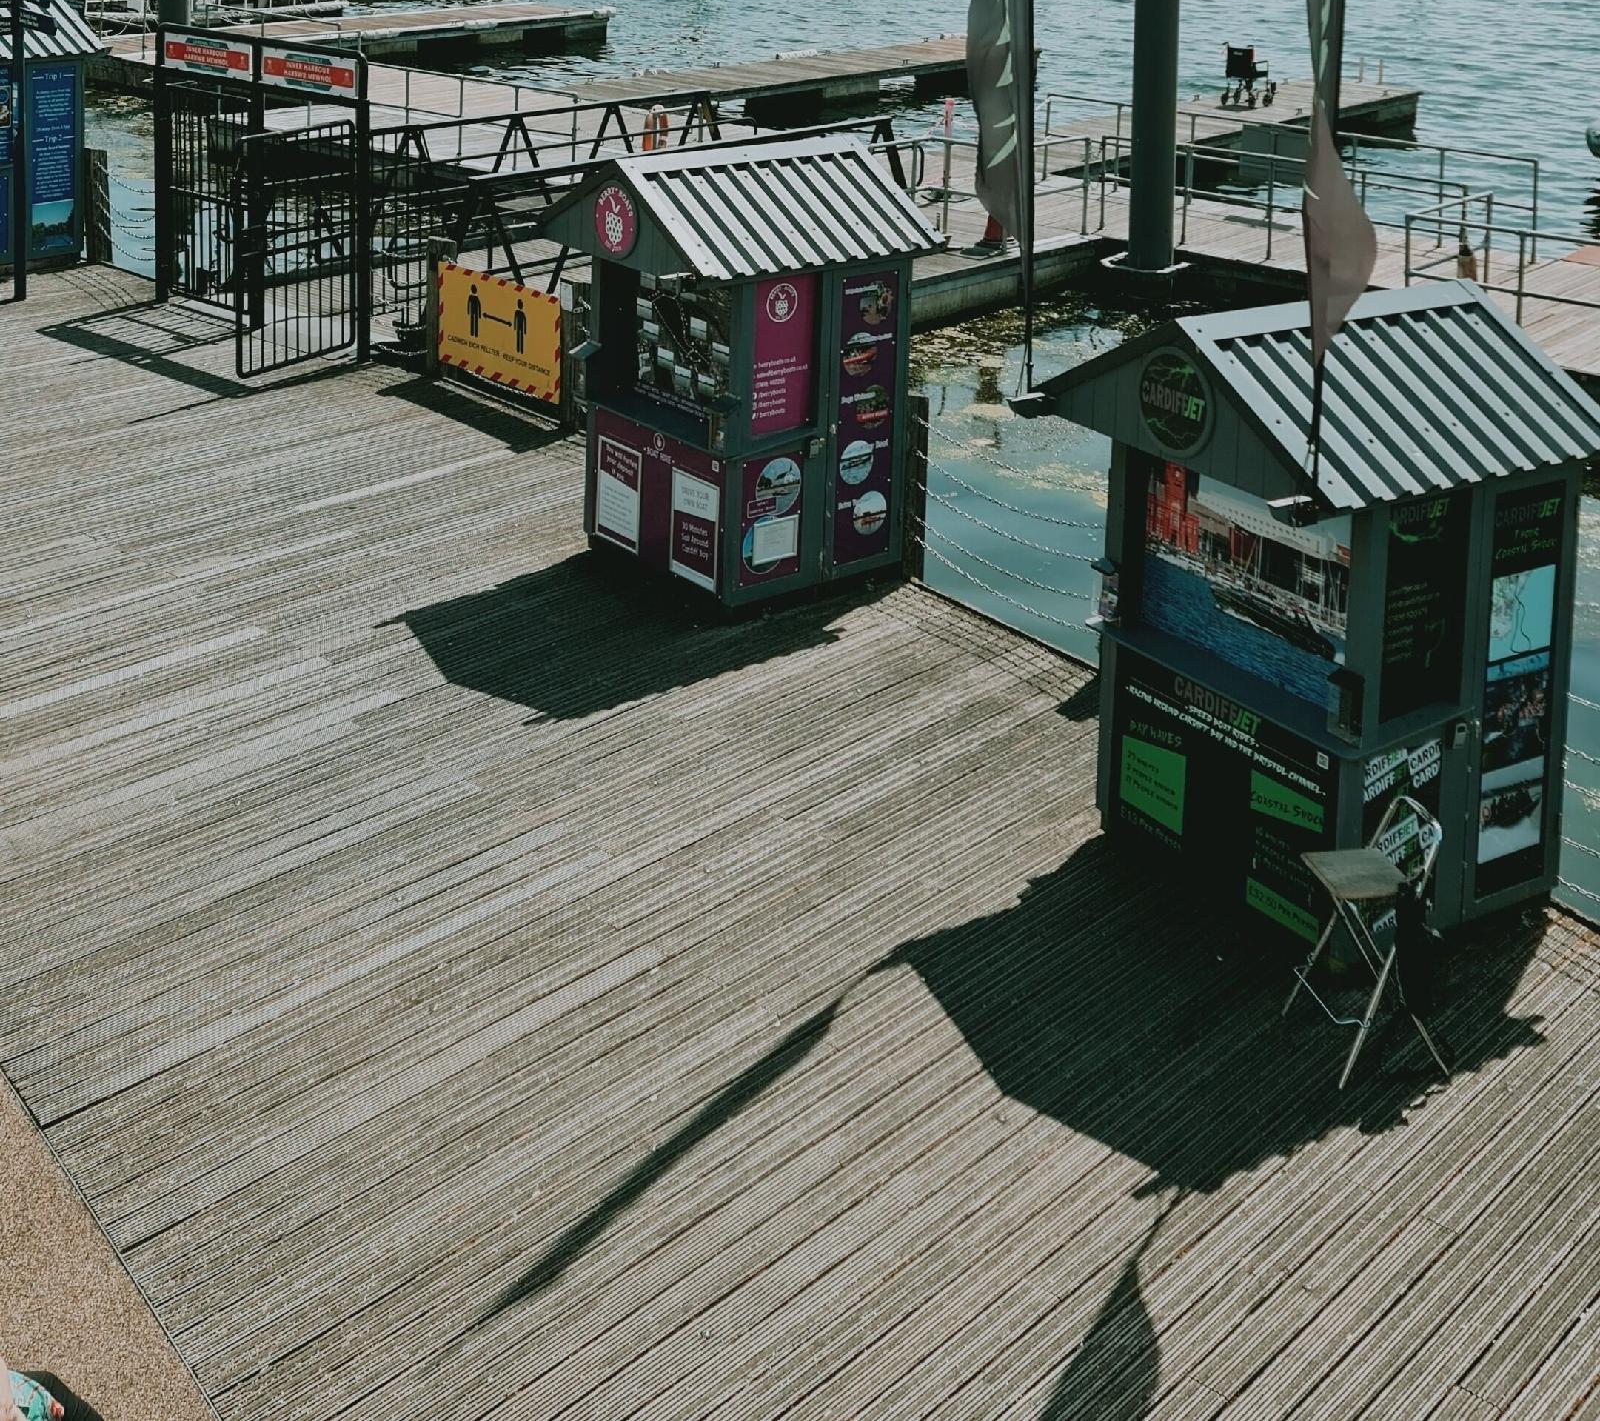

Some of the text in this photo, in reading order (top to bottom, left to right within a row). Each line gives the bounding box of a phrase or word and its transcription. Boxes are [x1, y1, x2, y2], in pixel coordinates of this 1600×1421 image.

[45, 73, 57, 81] Trip
[44, 135, 57, 144] Trip
[1142, 380, 1206, 423] CARDIFFJET
[1174, 676, 1262, 735] CARDIFFJET
